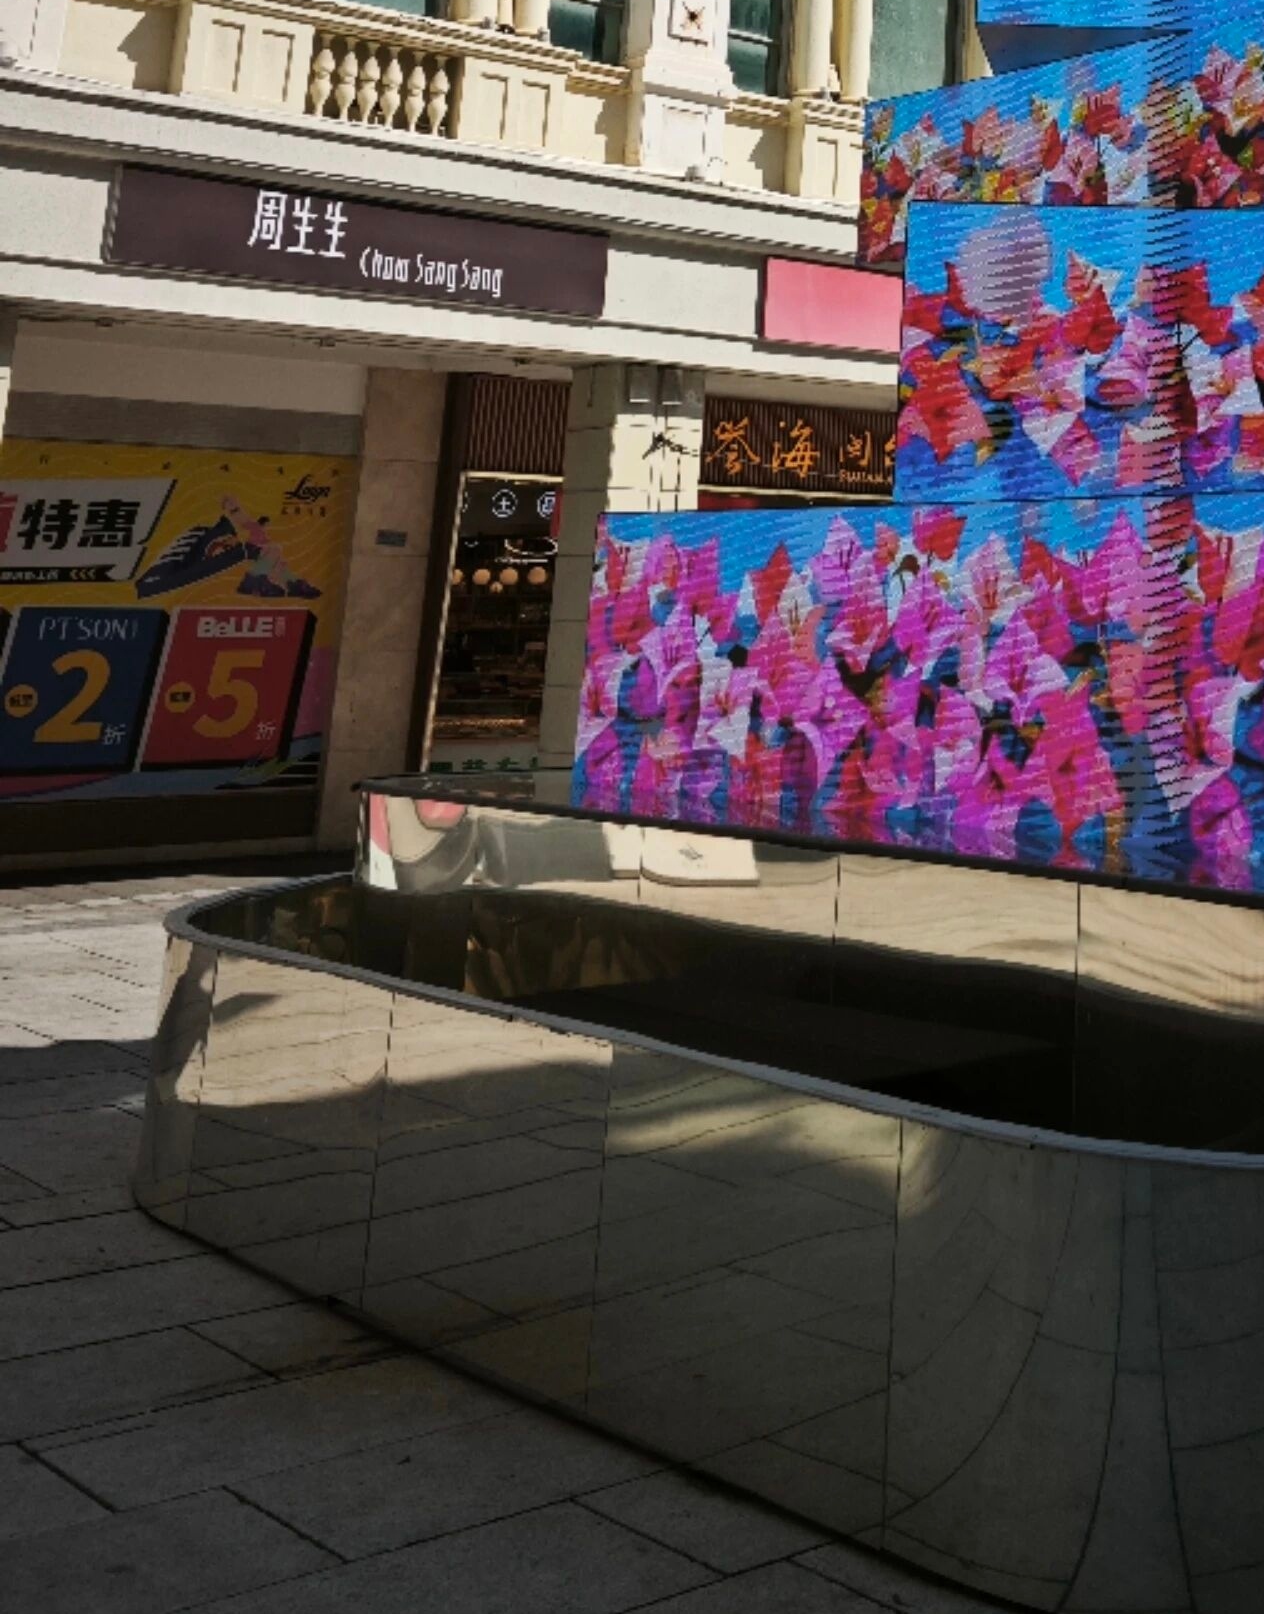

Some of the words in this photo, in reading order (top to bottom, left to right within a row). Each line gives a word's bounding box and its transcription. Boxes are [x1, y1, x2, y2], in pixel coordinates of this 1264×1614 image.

[247, 189, 348, 258] 周生生
[359, 246, 411, 283] Chow
[414, 253, 459, 292] Sang
[460, 258, 504, 298] Sang
